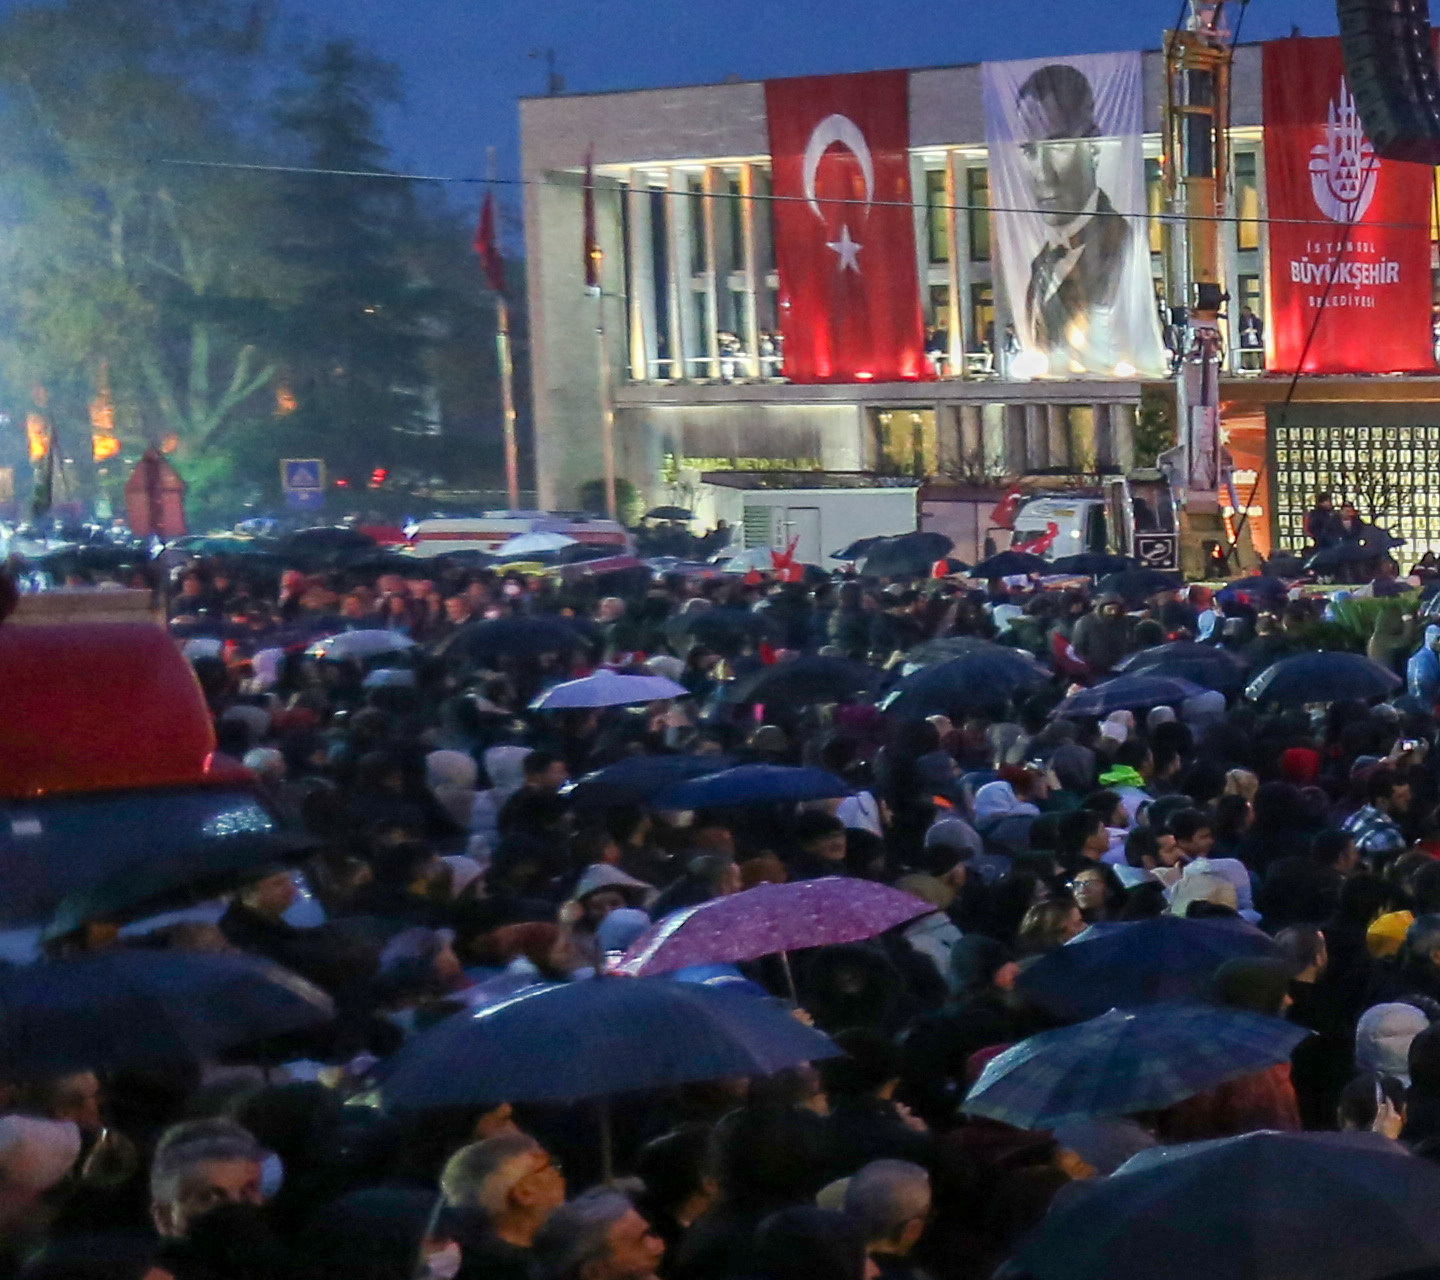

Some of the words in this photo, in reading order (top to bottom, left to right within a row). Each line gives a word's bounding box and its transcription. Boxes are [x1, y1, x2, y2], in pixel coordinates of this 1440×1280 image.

[1306, 240, 1376, 254] İSTANBUL
[1290, 257, 1400, 290] BÜYÜKŞEHİR
[1308, 293, 1376, 308] BELEDİYESİ
